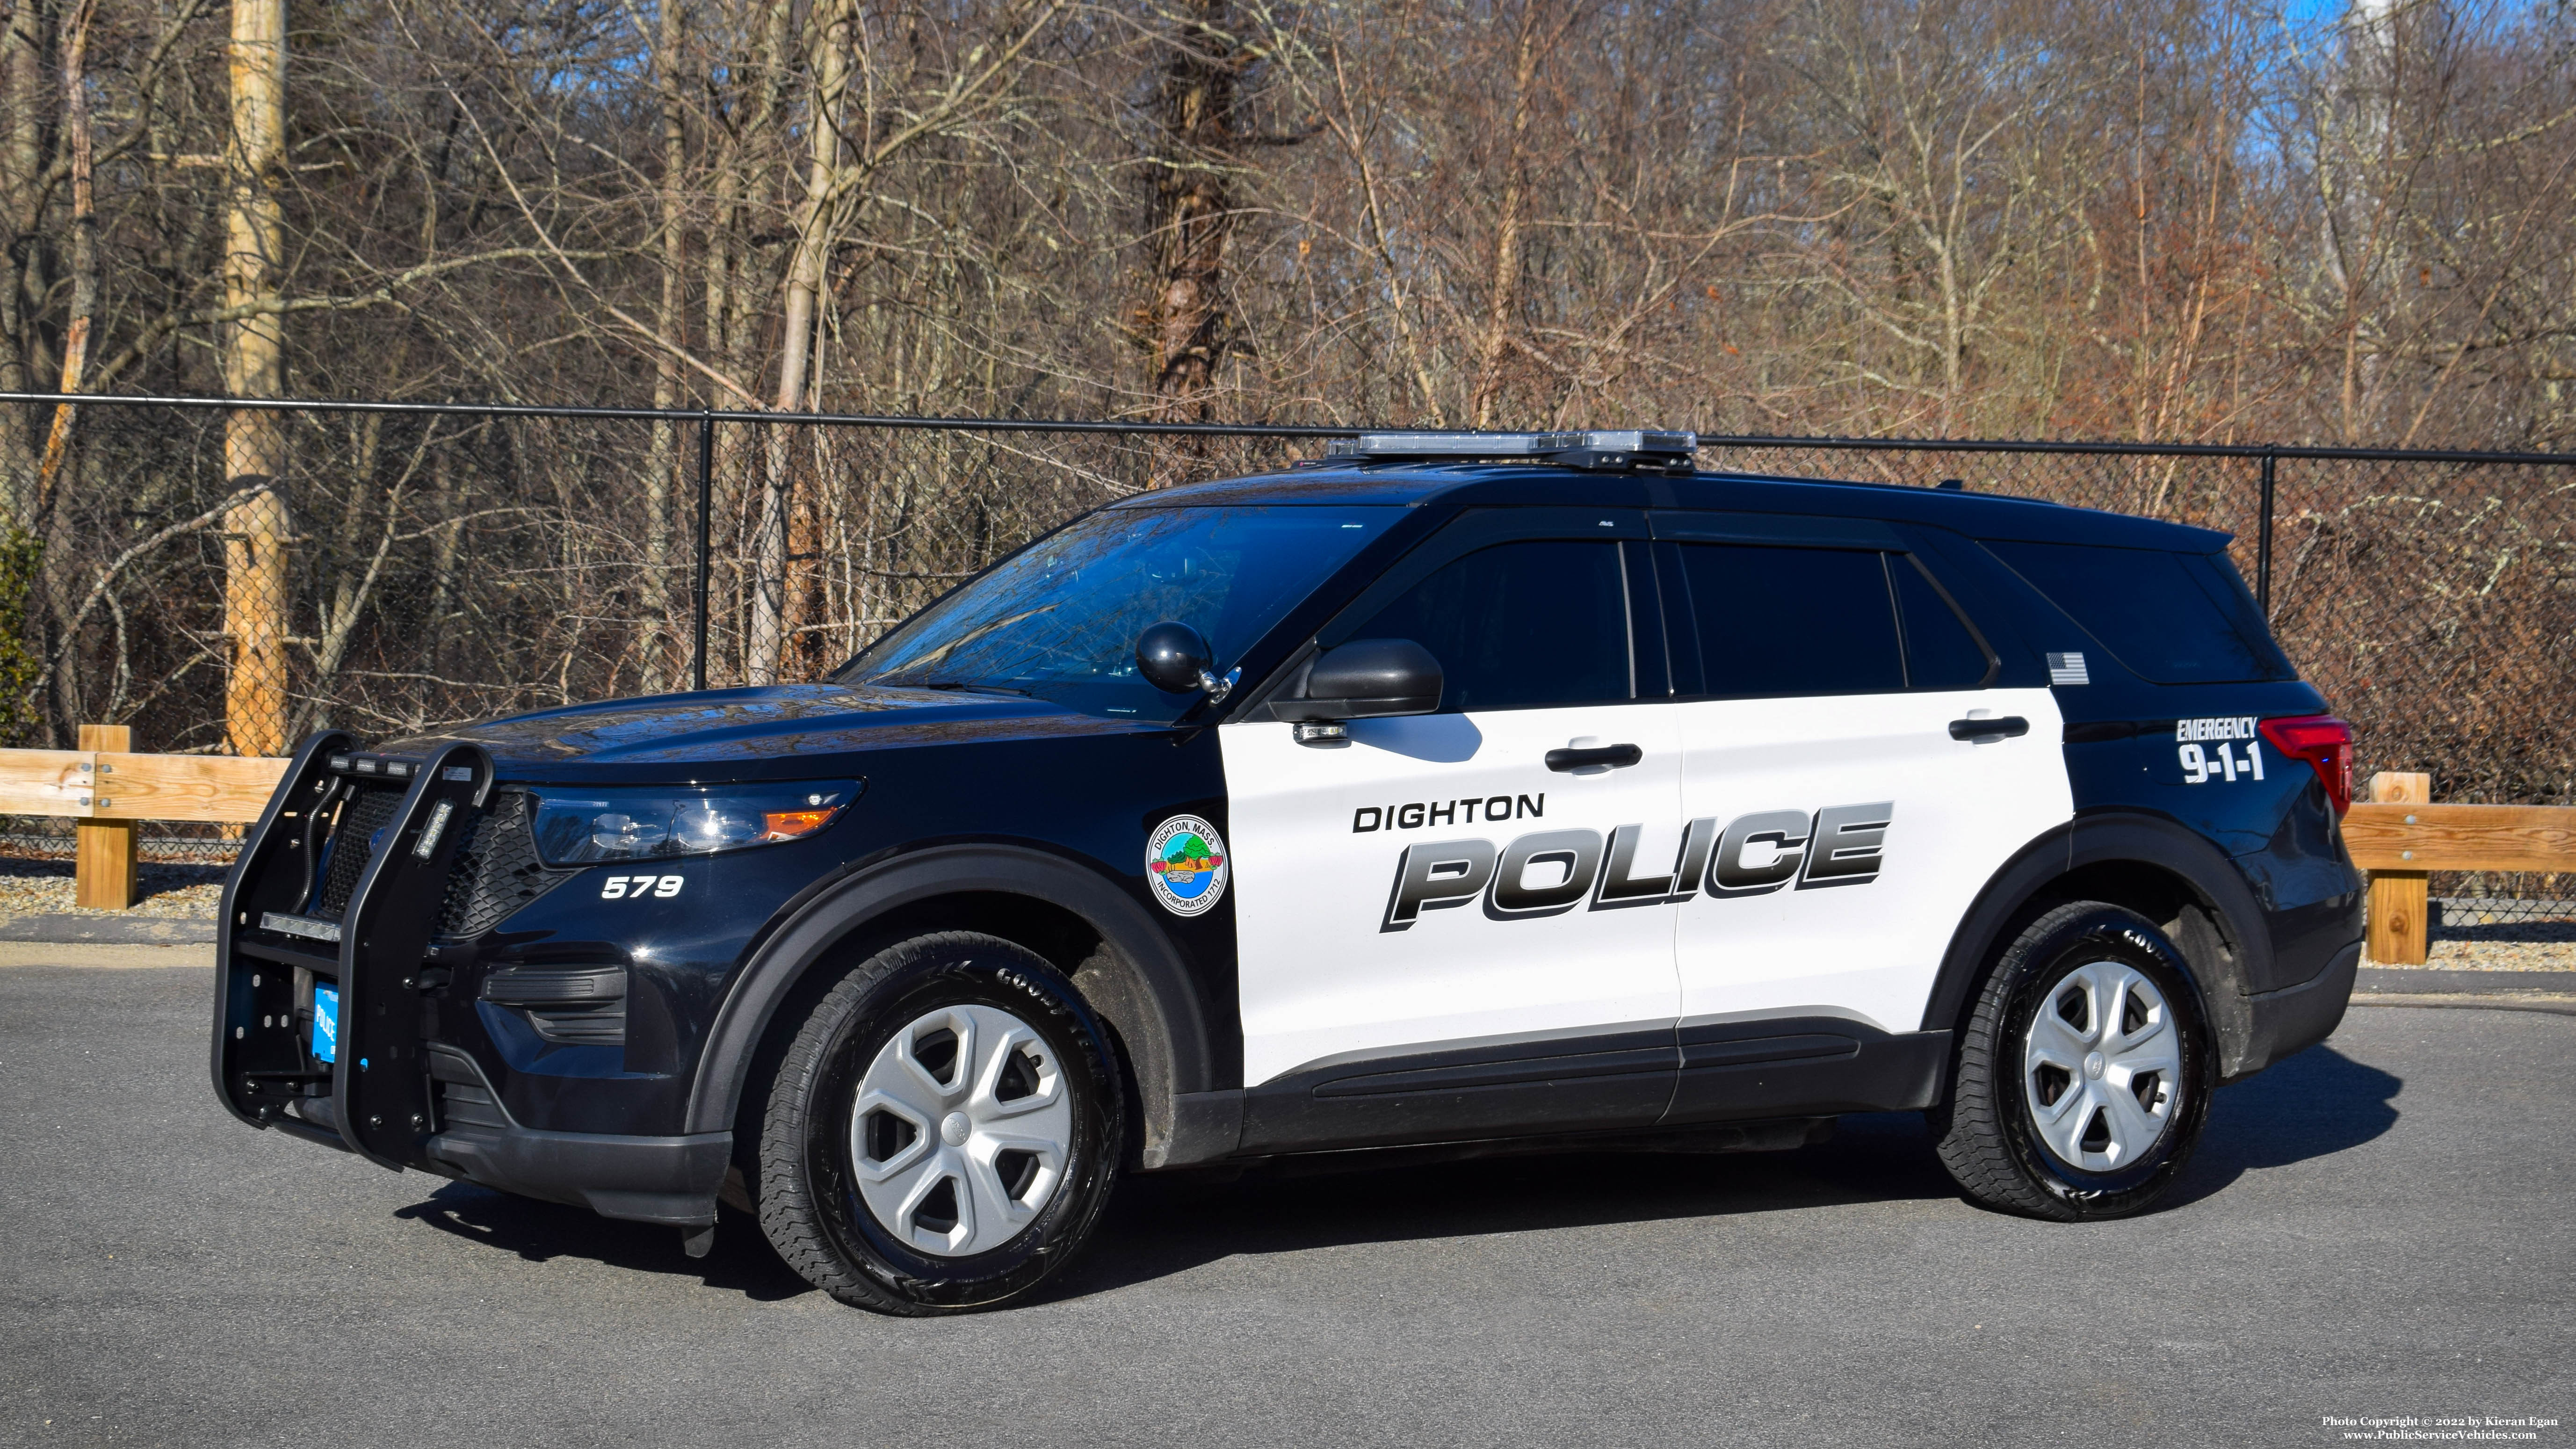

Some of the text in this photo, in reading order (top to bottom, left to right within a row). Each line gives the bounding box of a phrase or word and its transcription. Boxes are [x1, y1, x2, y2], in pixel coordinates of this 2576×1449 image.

[2176, 717, 2258, 742] EMERGENCY
[2179, 741, 2264, 783] 9-1-1
[1353, 792, 1545, 834] DIGHTON
[1154, 821, 1215, 850] DIGHTON, MASS.
[1379, 800, 1895, 934] POLICE
[601, 875, 684, 899] 579
[1157, 878, 1221, 908] INCORPORATED 1712
[316, 1004, 335, 1042] POLICE
